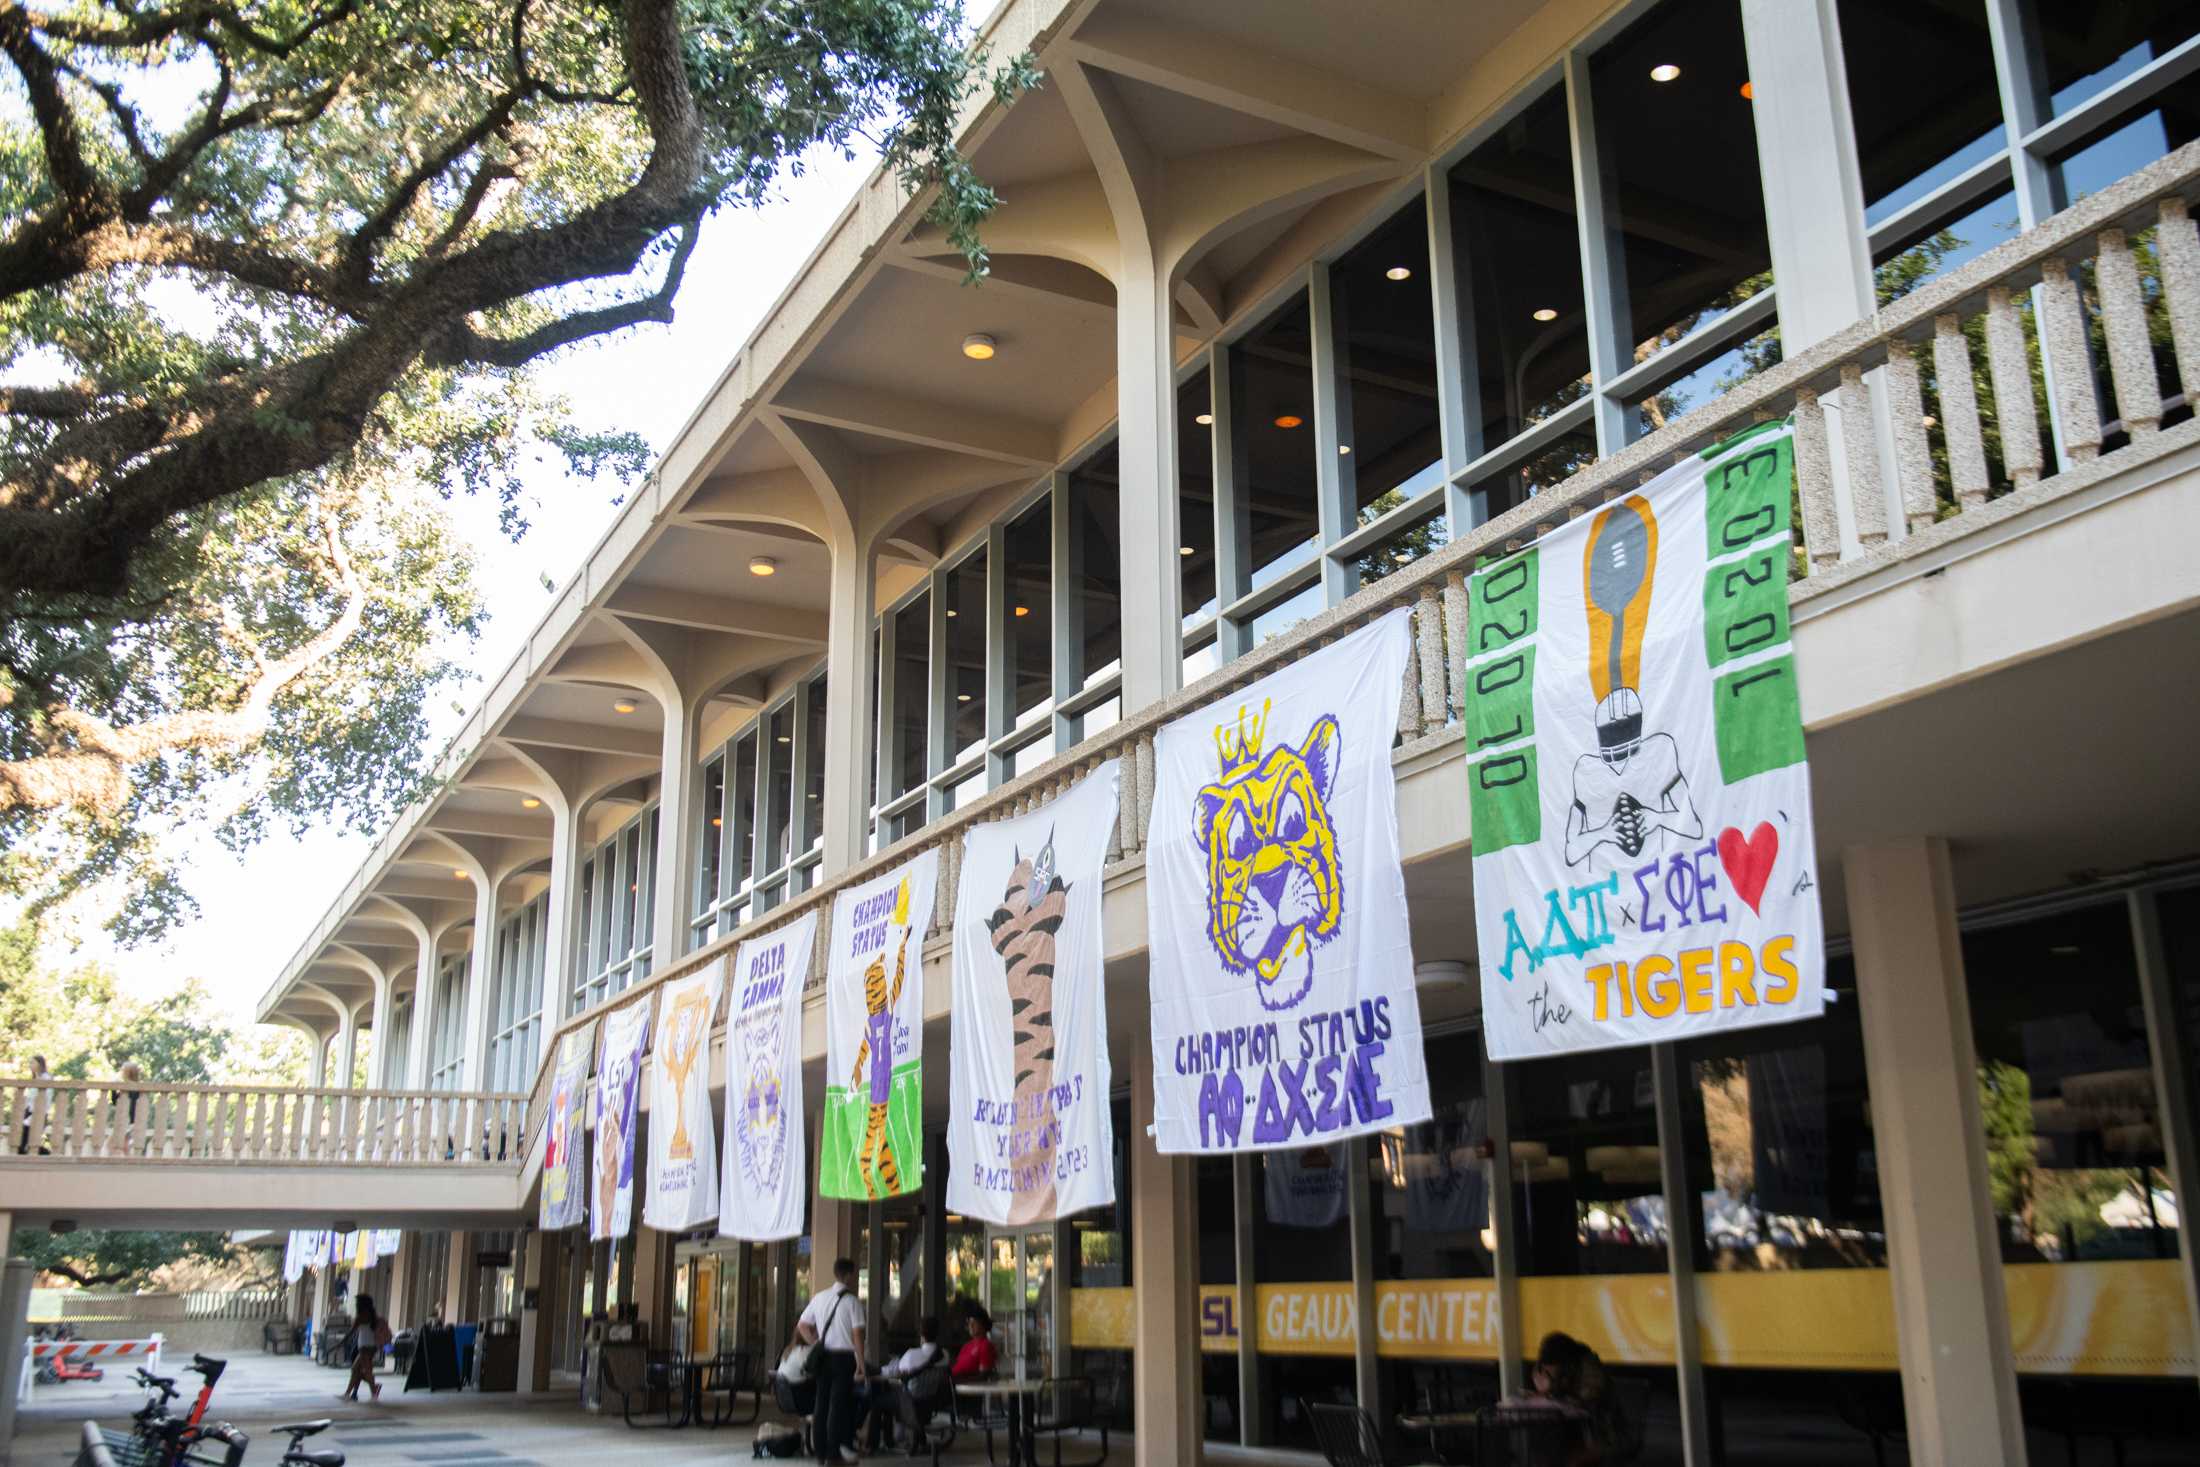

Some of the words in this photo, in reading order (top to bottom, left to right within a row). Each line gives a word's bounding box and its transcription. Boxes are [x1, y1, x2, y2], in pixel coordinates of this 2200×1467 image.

[852, 883, 900, 929] CHAMPION
[749, 942, 785, 981] DELTA
[851, 919, 889, 959] STATUS
[742, 972, 785, 1011] GAMMA
[1527, 982, 1573, 1033] the
[1585, 934, 1800, 1022] TIGERS
[1300, 995, 1393, 1060] STATUS
[1266, 1294, 1358, 1341] GEAUX
[1377, 1291, 1503, 1342] CENTER
